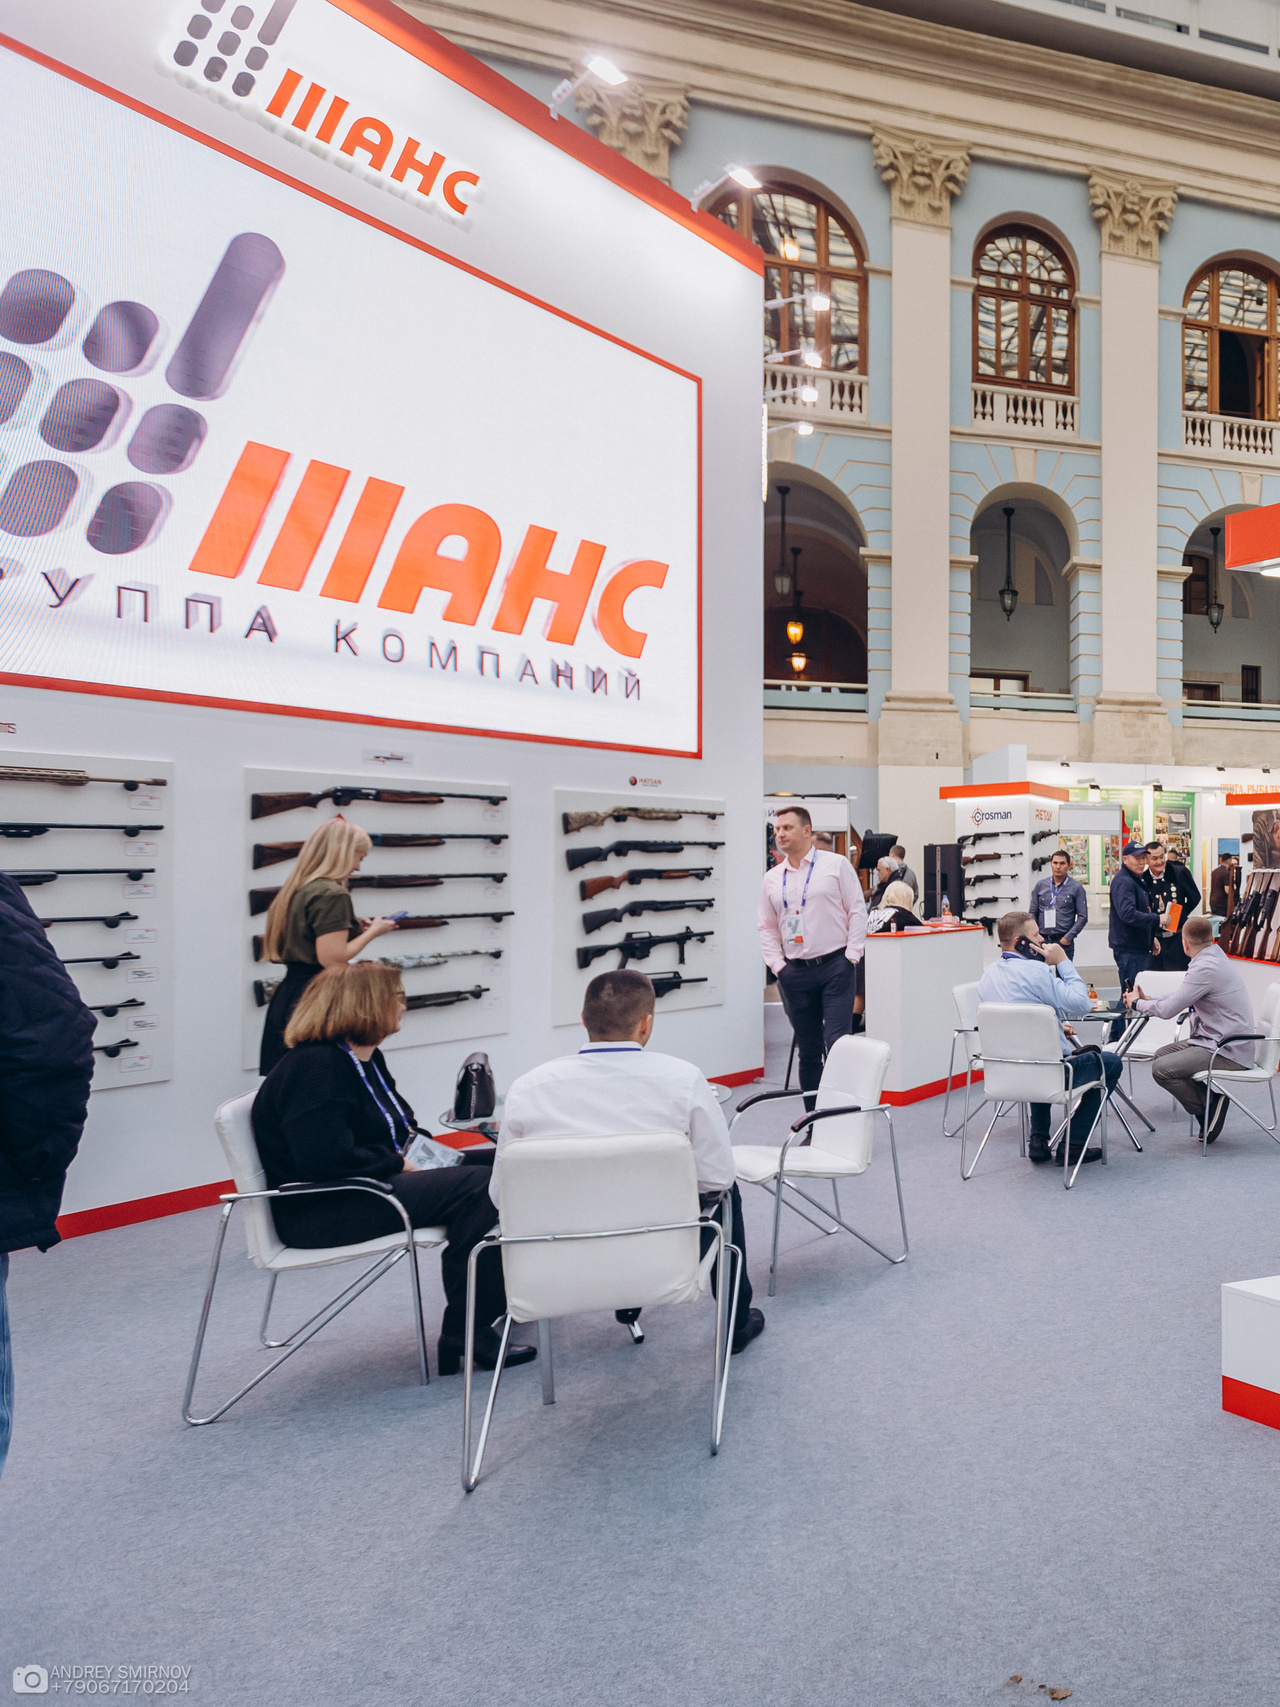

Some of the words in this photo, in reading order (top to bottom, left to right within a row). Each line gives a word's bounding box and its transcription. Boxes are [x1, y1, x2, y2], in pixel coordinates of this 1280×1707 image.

[265, 68, 480, 216] ШАНС
[188, 441, 669, 660] ШАНС
[0, 566, 276, 642] УППА
[334, 618, 641, 701] КОМПАНИЙ
